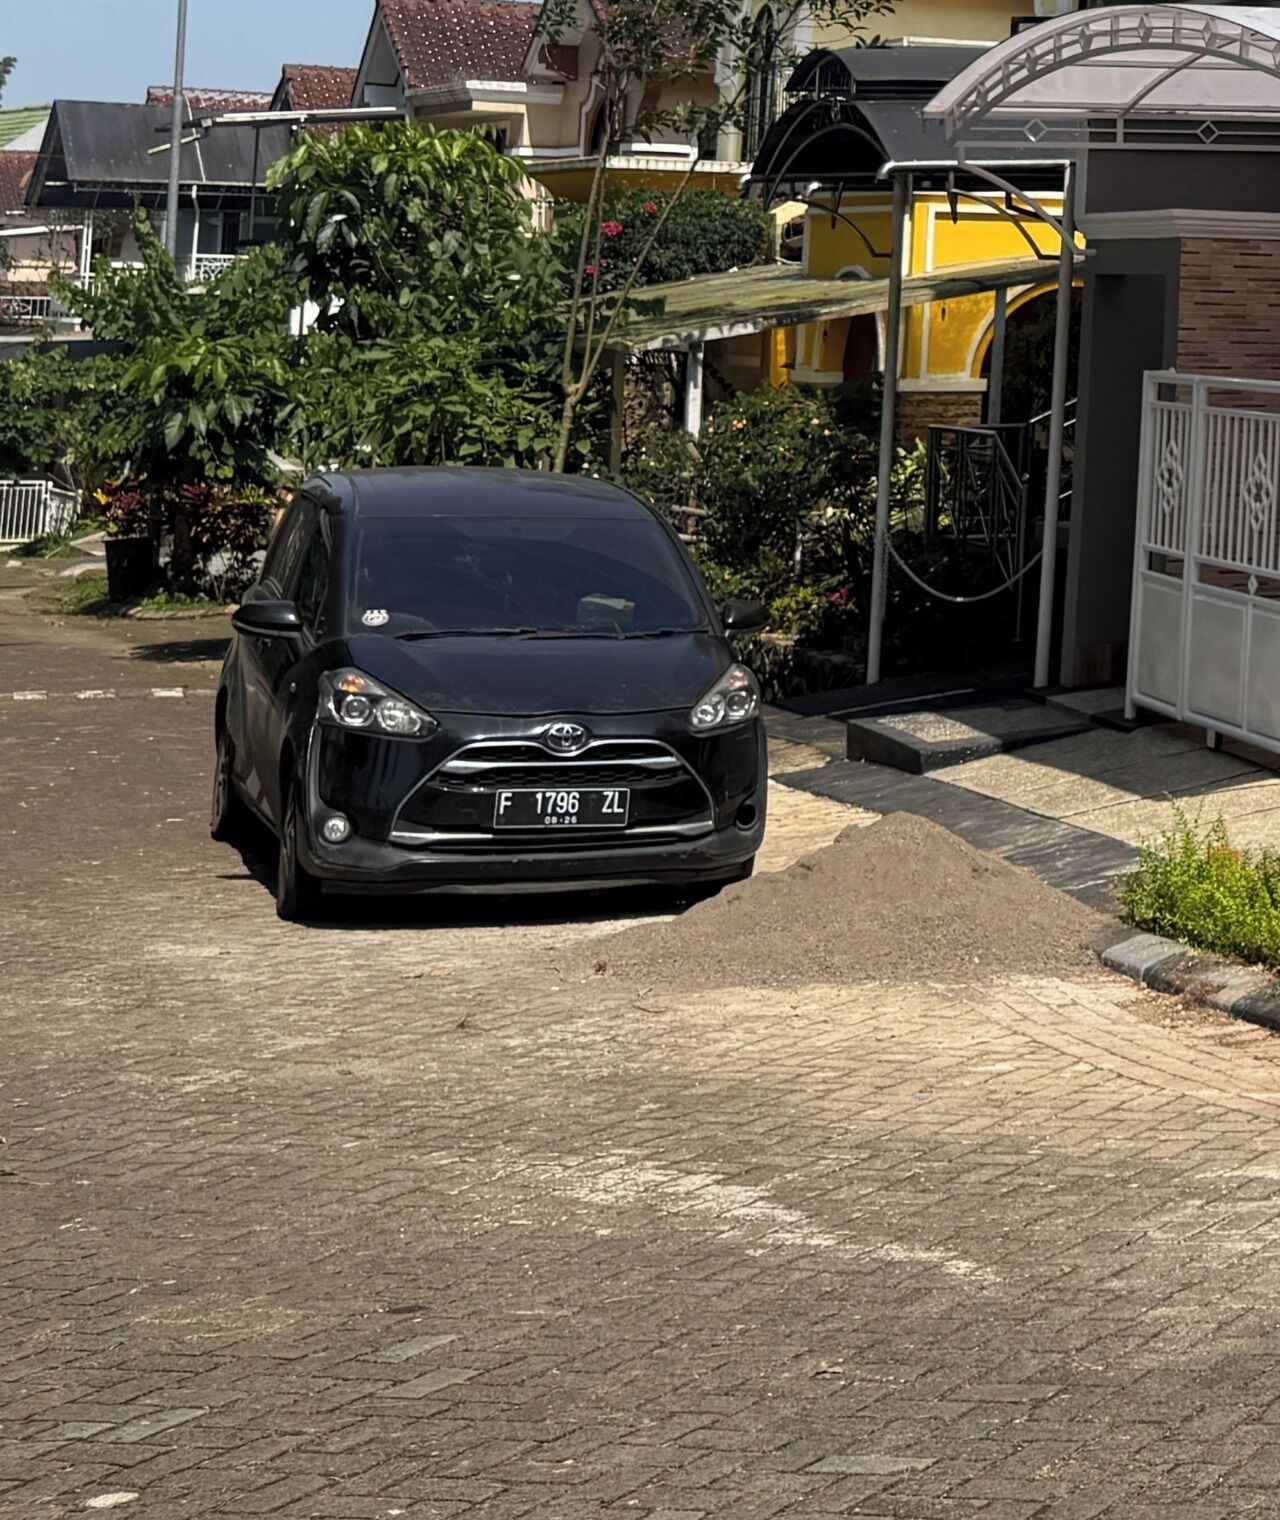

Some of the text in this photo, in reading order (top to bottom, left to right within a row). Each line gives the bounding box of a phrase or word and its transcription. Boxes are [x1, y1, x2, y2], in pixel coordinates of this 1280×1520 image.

[499, 791, 624, 815] F 1796 ZL
